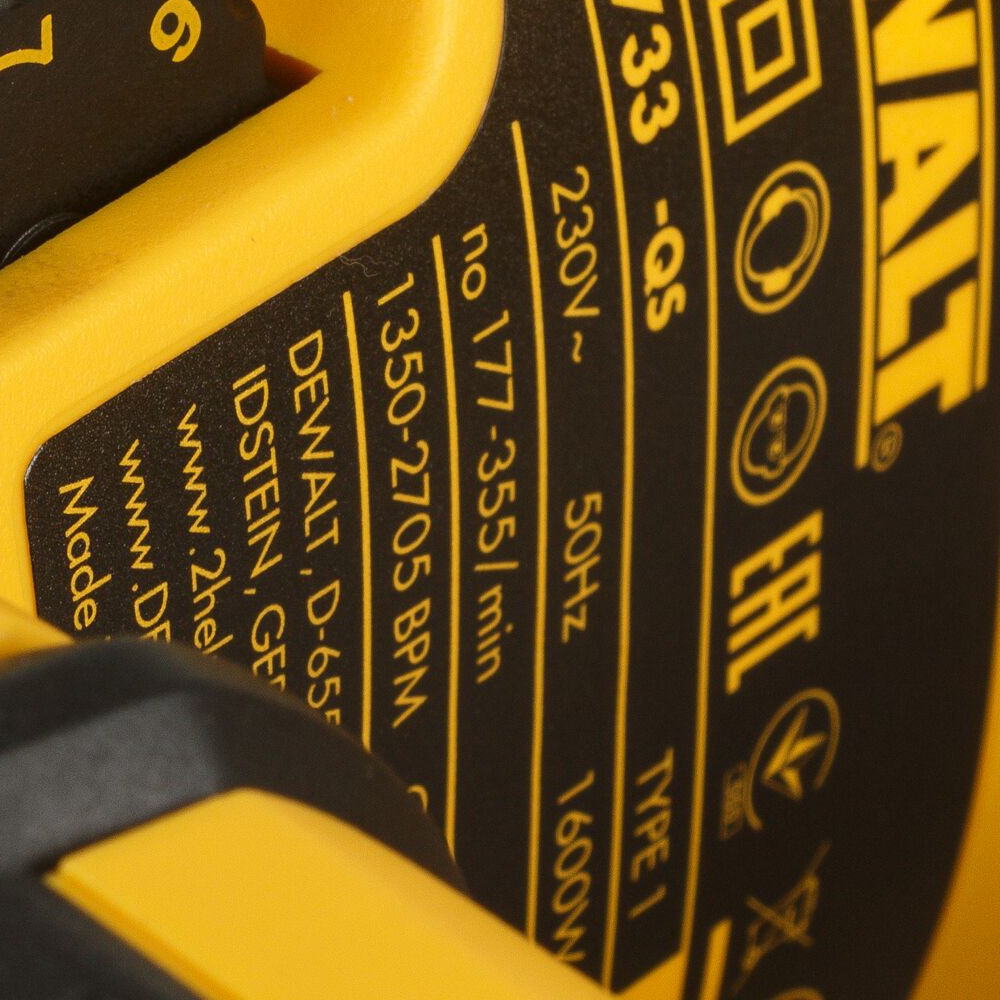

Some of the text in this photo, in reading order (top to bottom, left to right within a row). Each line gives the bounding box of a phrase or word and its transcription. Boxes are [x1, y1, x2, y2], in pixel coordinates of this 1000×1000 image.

[550, 165, 600, 318] 230V
[58, 477, 112, 631] Made
[377, 272, 431, 728] 1350-2705 BPM
[562, 492, 603, 643] 50Hz
[552, 771, 594, 962] 1600W
[632, 749, 674, 880] TYPE
[631, 887, 665, 917] 1
